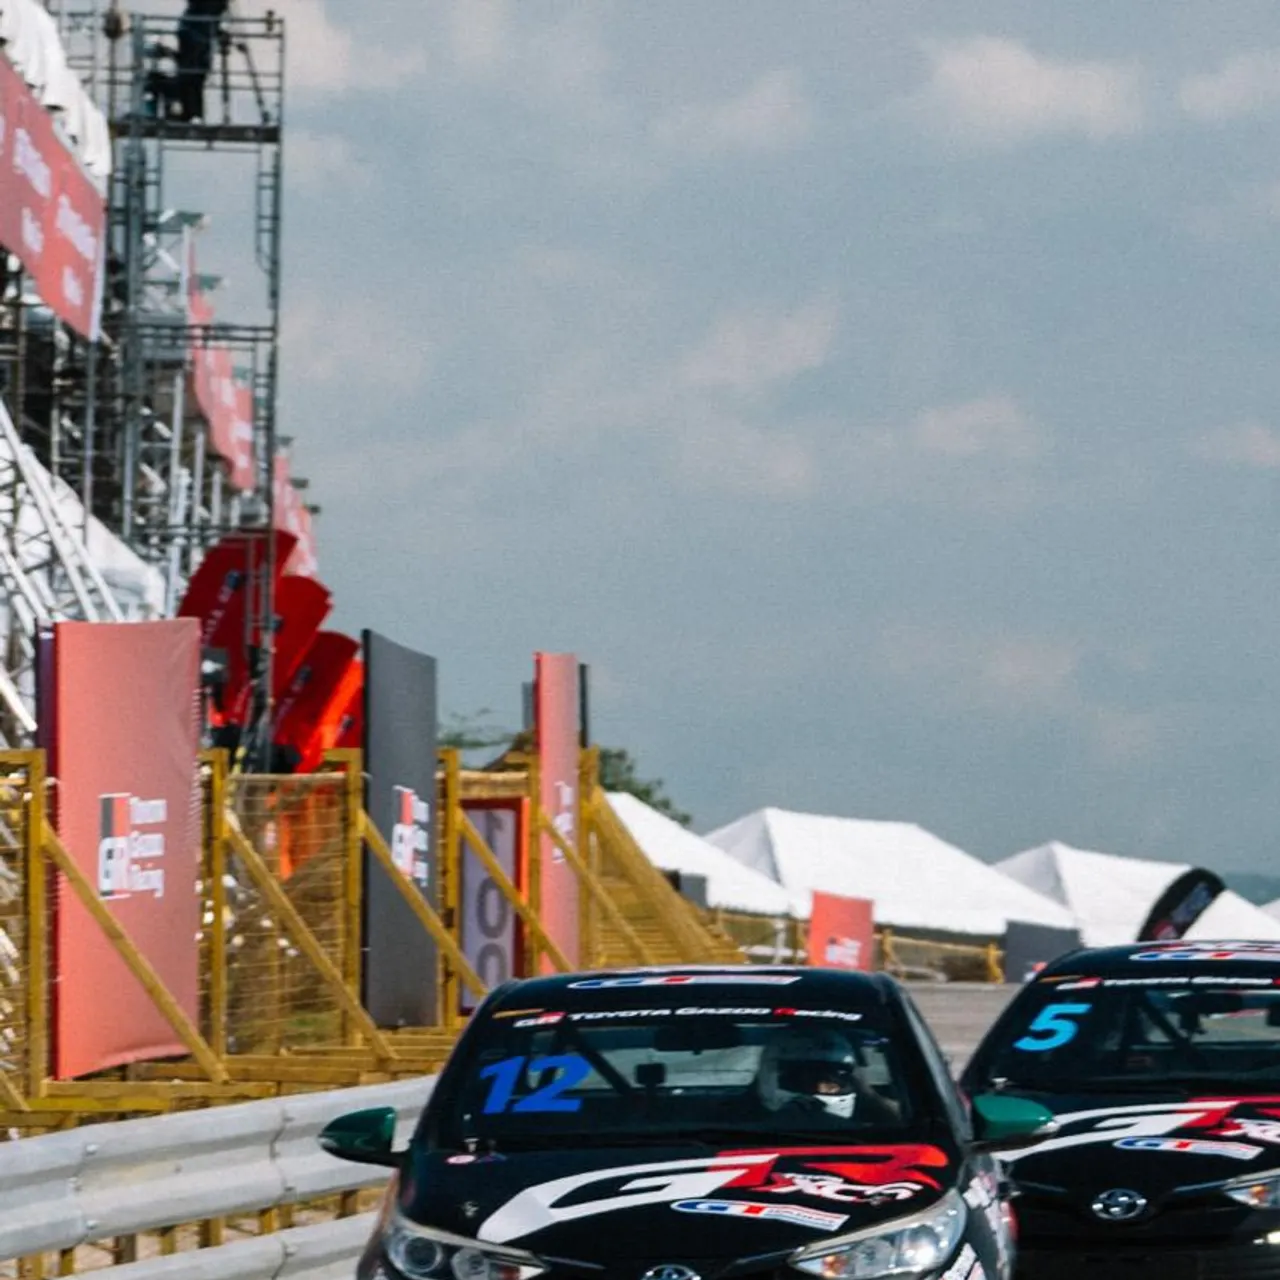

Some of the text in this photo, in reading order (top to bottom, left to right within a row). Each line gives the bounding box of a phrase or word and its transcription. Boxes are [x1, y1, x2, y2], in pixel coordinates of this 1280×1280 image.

[567, 1009, 671, 1022] TOYOTA
[675, 1006, 772, 1016] GAZOO
[1013, 1003, 1092, 1051] 5
[480, 1055, 593, 1114] 12
[478, 1144, 949, 1242] GR
